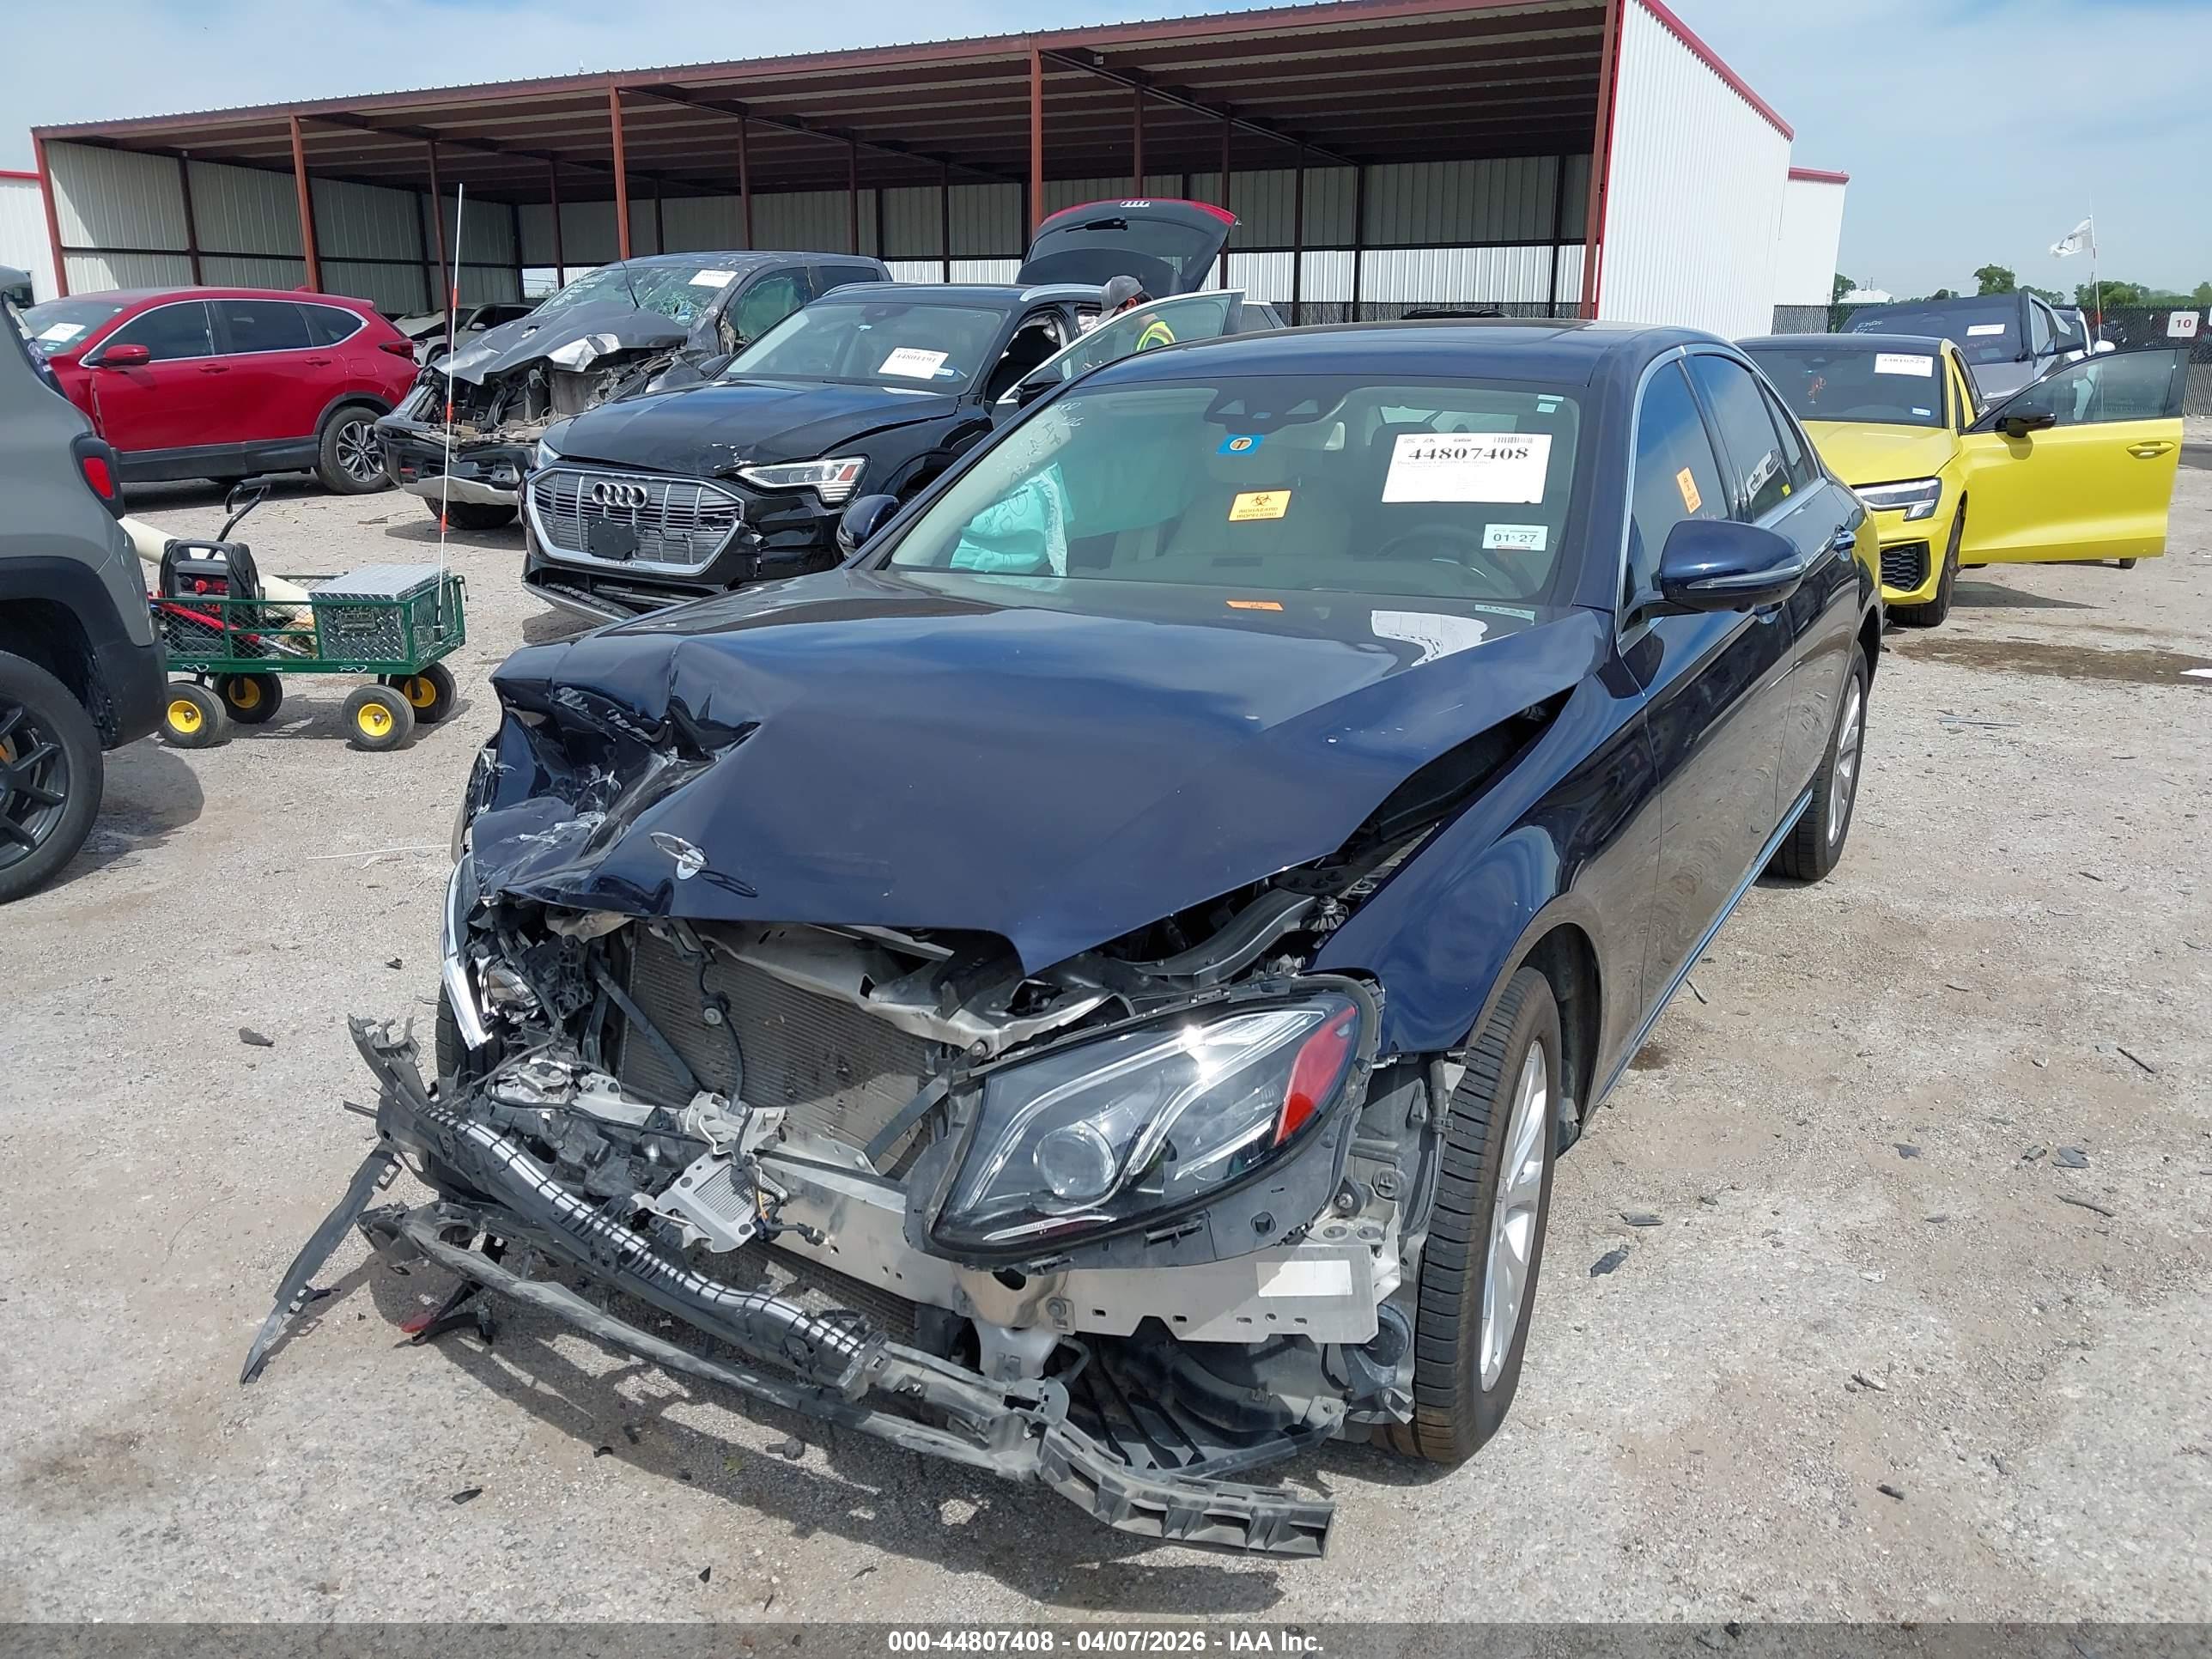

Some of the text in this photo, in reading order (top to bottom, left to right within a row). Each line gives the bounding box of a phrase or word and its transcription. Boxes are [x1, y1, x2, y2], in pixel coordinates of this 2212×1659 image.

[2176, 319, 2192, 328] 10
[1408, 447, 1528, 460] 44807408
[1493, 533, 1537, 543] 01 27
